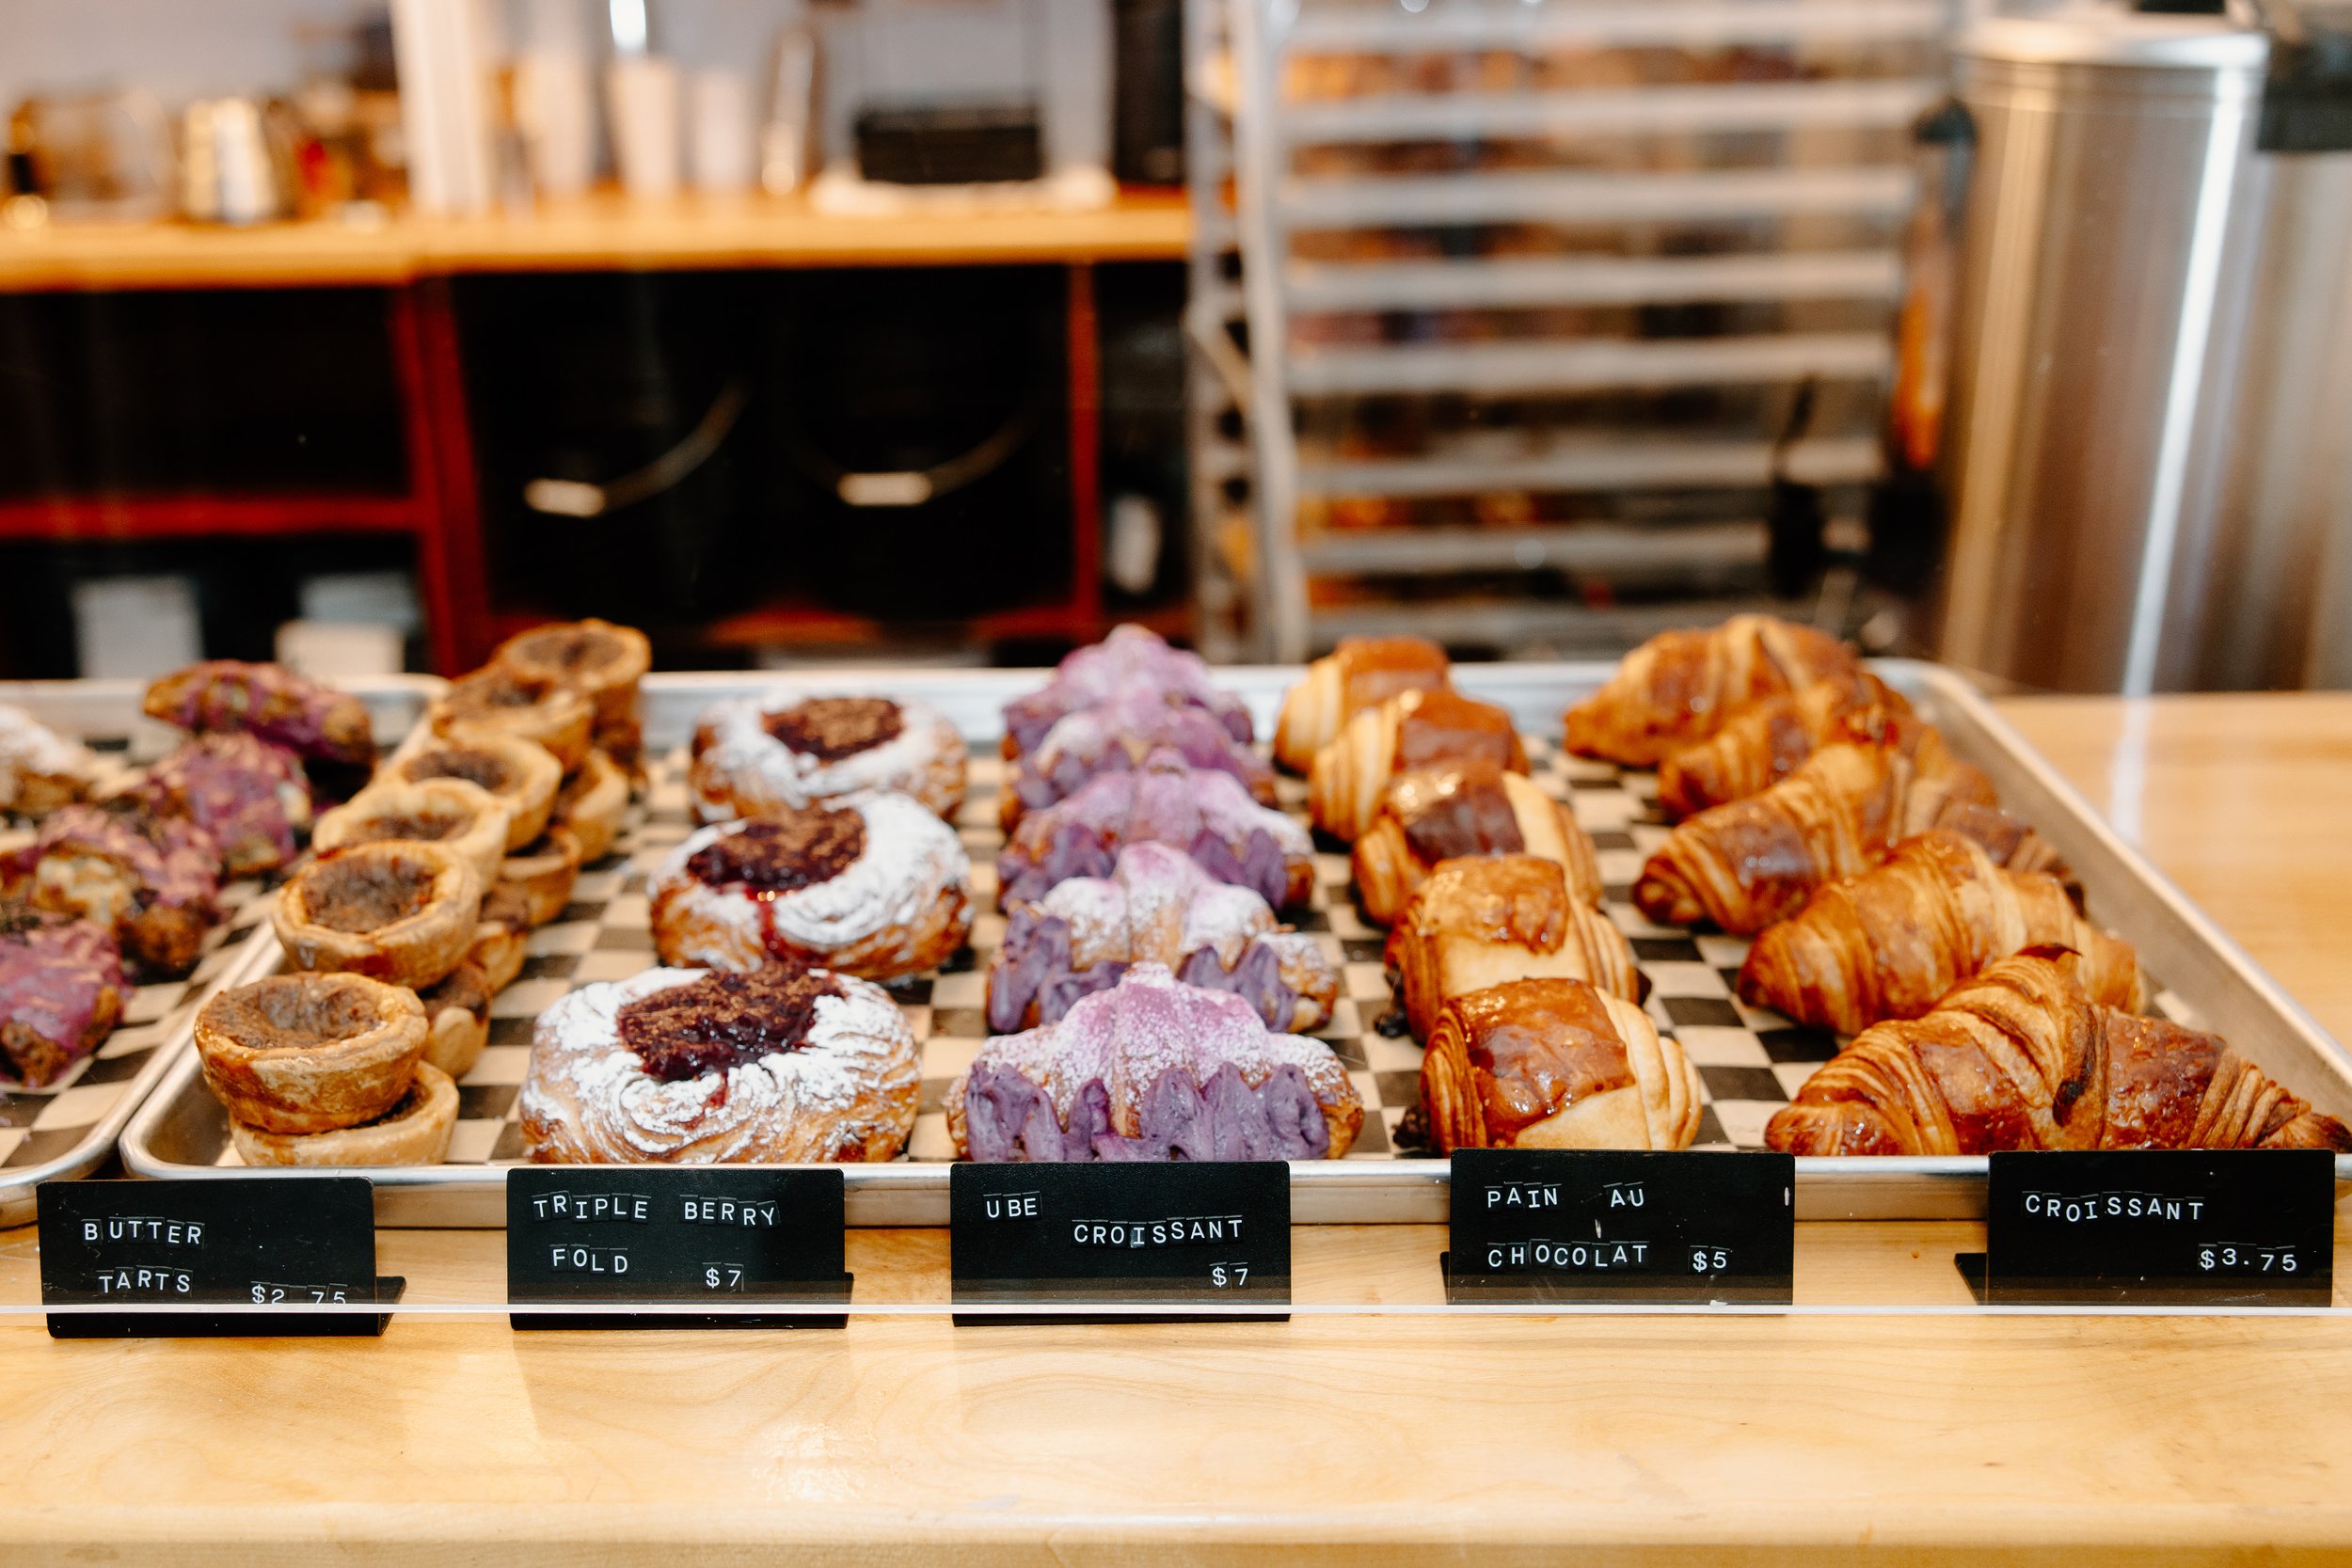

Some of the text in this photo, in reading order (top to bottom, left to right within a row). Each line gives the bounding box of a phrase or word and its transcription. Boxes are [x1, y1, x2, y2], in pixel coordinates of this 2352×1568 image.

[532, 1195, 775, 1226] TRIPLE BERRY
[986, 1197, 1037, 1218] UBE
[1487, 1187, 1645, 1209] PAIN AU
[2026, 1195, 2203, 1223] CROISSANT
[84, 1221, 201, 1245] BUTTER
[1073, 1219, 1243, 1245] CROISSANT
[552, 1248, 741, 1290] FOLD $7
[1487, 1244, 1727, 1273] CHOCOLAT $5
[2200, 1247, 2296, 1272] $3.75
[98, 1269, 347, 1304] TARTS $275
[1212, 1265, 1248, 1289] $7
